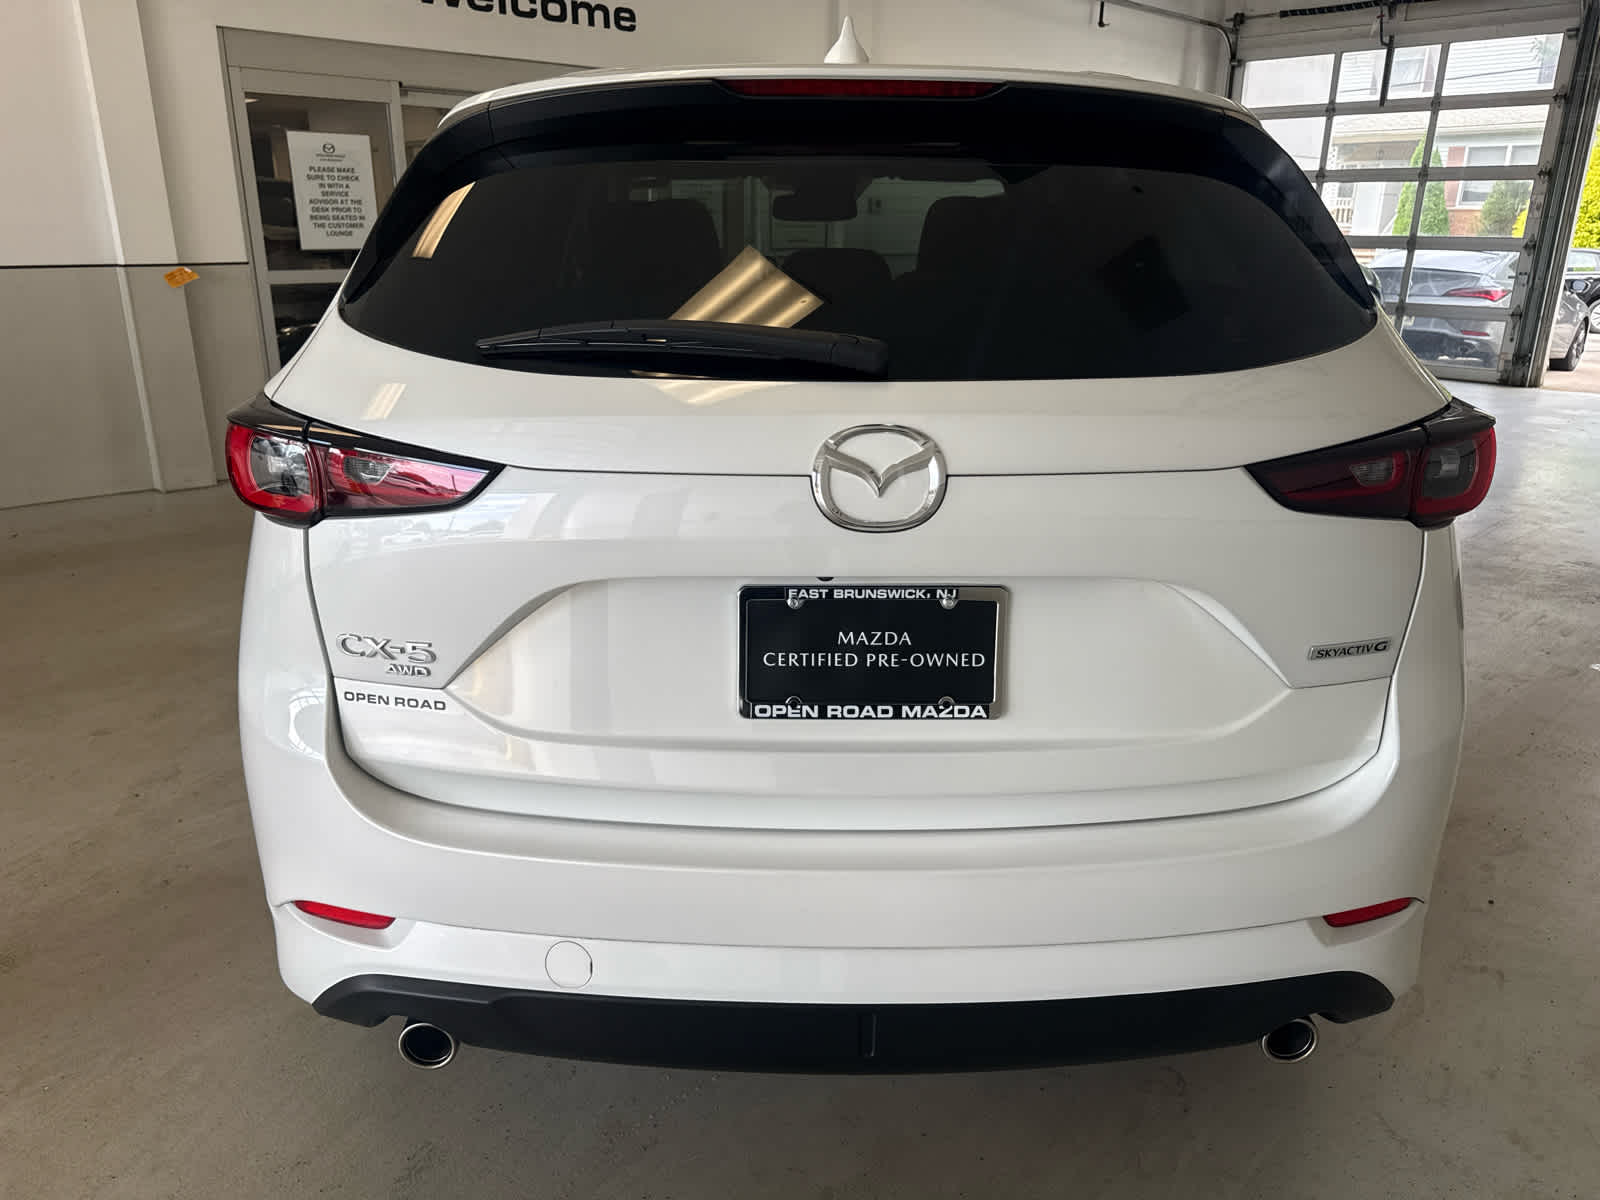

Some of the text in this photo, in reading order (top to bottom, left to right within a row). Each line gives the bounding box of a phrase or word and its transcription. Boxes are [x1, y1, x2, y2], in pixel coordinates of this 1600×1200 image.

[420, 0, 637, 32] ecome
[788, 589, 957, 599] EAST BRUNSWICK, NJ
[837, 631, 912, 646] MAZDA
[336, 633, 437, 664] CX-5
[762, 652, 986, 668] CERTIFIED PRE-OWNED
[385, 663, 431, 677] AWD
[344, 691, 446, 711] OPEN ROAD
[754, 704, 988, 719] OPEN ROAD MAZDA
